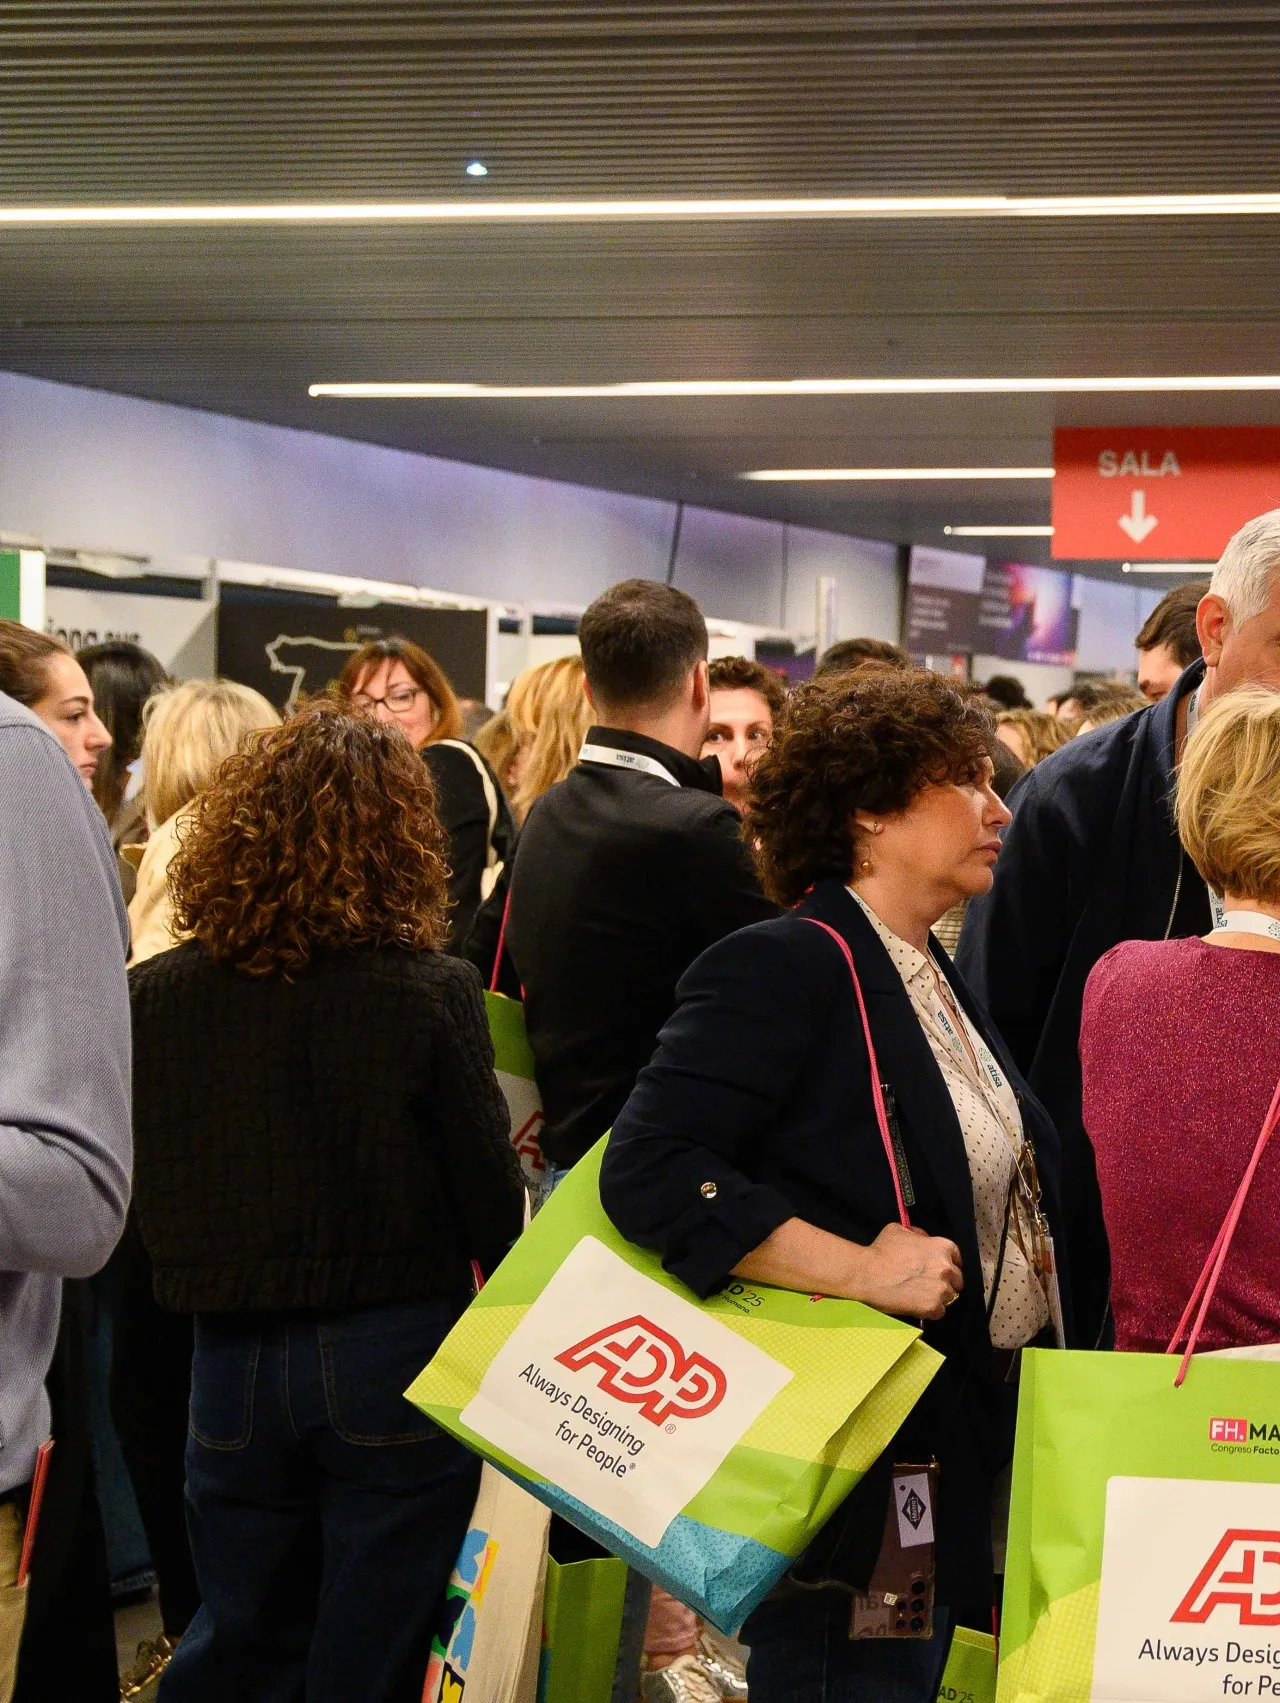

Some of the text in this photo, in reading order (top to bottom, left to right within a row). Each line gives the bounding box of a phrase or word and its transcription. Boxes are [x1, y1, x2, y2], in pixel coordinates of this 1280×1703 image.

[1098, 449, 1182, 477] SALA
[937, 1010, 954, 1036] atisa
[987, 1064, 1003, 1088] atisa
[518, 1363, 646, 1457] Always Designing
[555, 1420, 579, 1445] for
[1211, 1419, 1245, 1441] FH.
[1210, 1443, 1252, 1456] Congreso
[1138, 1638, 1219, 1667] Always
[1222, 1673, 1253, 1695] for
